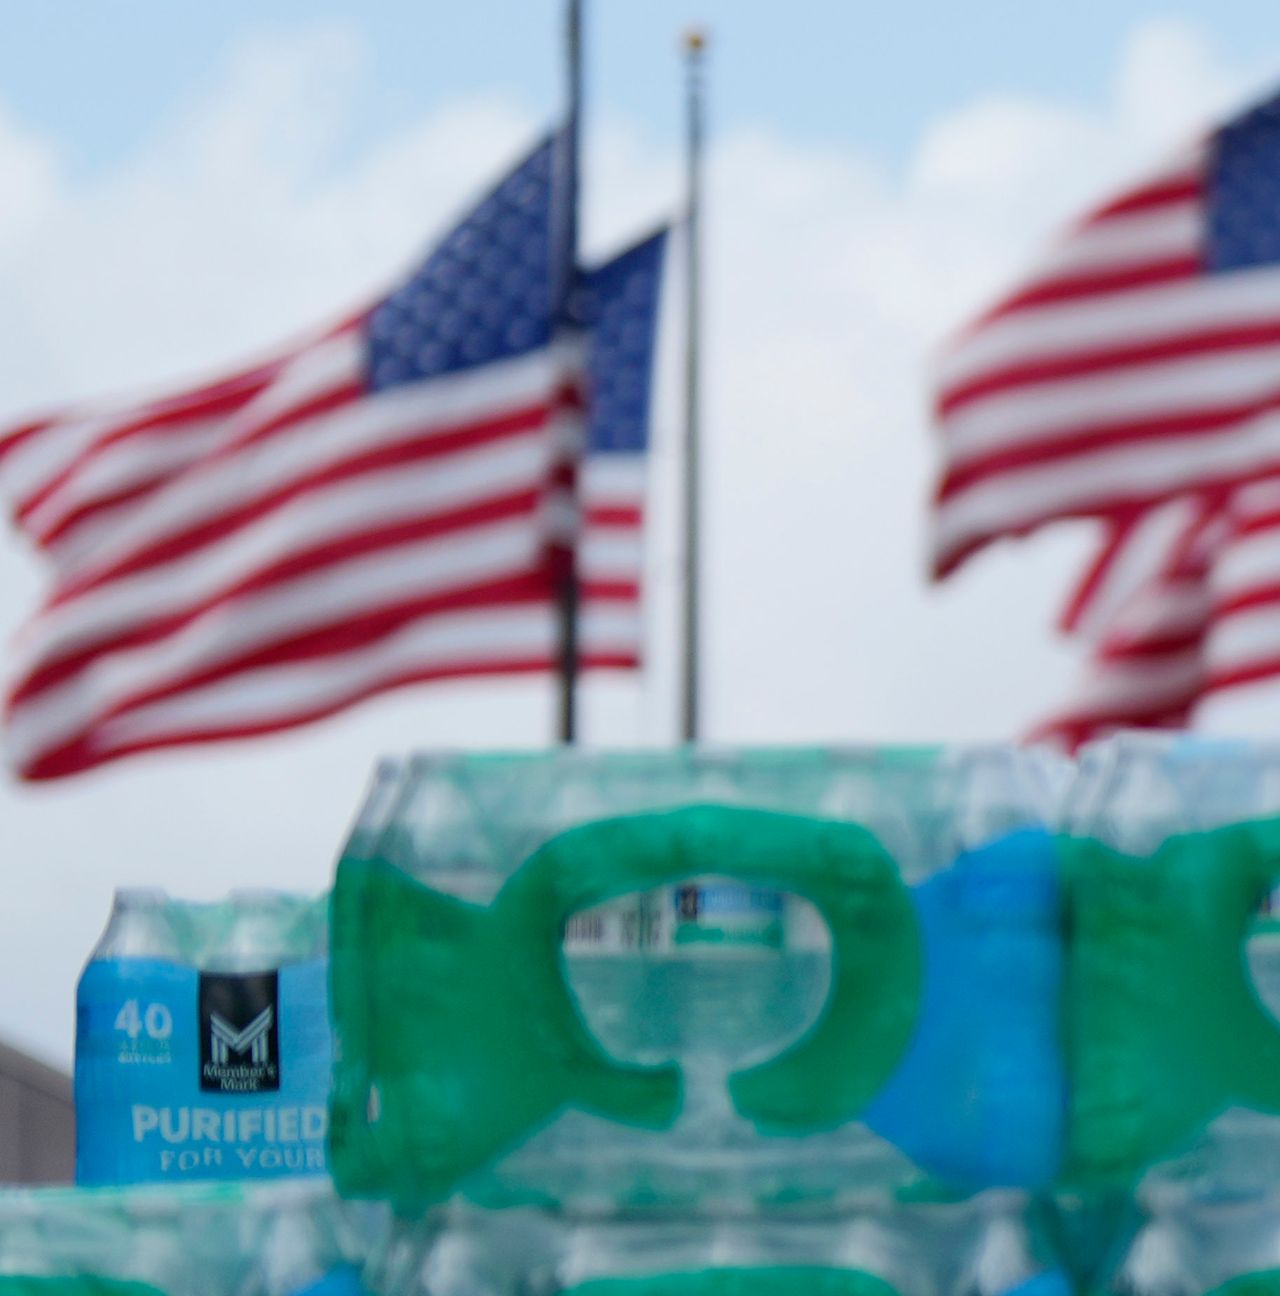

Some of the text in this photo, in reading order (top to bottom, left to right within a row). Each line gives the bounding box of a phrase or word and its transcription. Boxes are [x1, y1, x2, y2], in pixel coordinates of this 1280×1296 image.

[114, 998, 173, 1040] 40
[203, 1060, 277, 1079] Member's
[220, 1077, 259, 1091] Mark
[131, 1105, 327, 1143] PURIFIED
[160, 1147, 326, 1172] FOR YOUR
